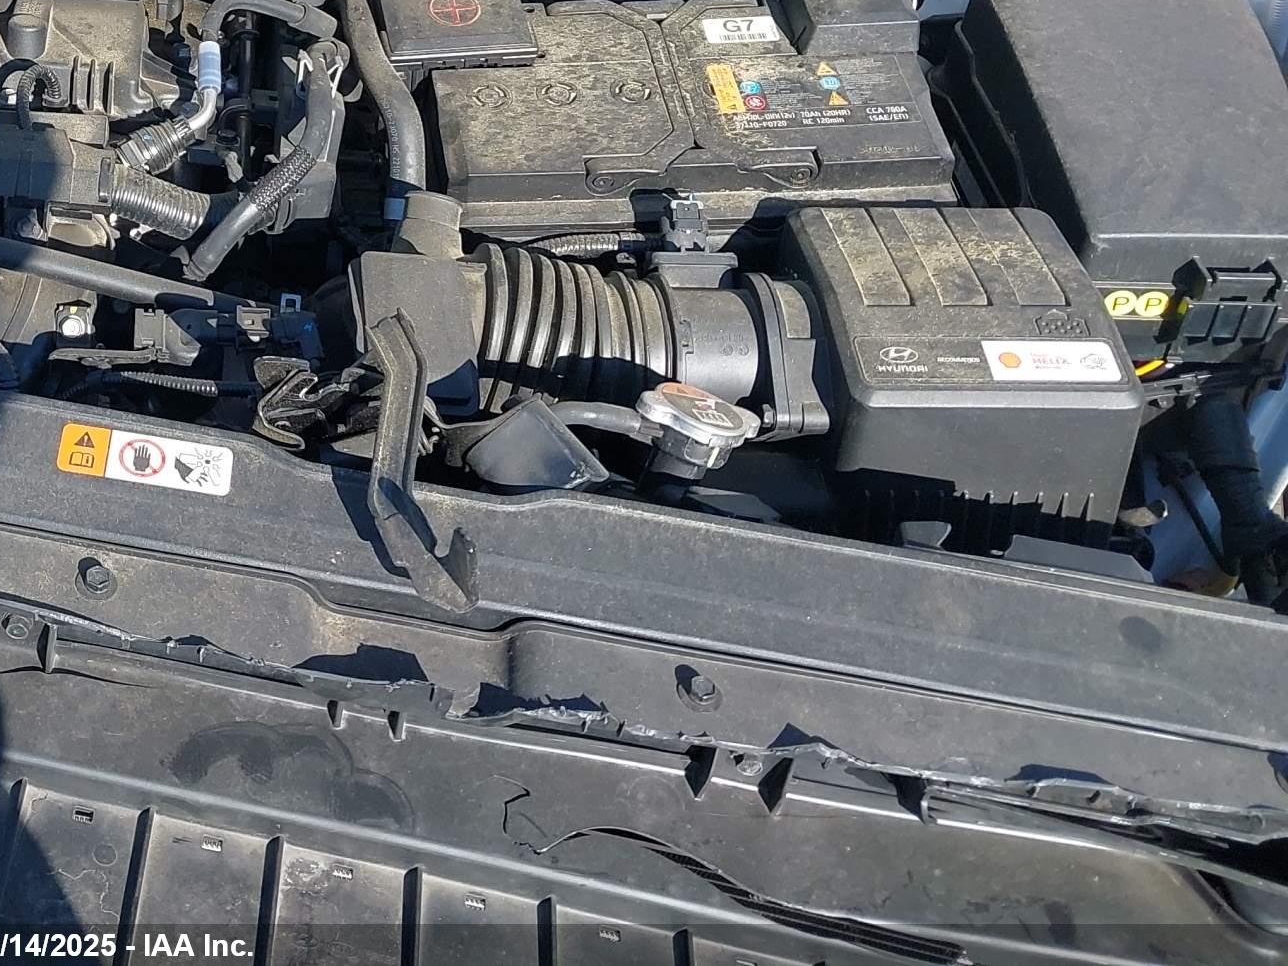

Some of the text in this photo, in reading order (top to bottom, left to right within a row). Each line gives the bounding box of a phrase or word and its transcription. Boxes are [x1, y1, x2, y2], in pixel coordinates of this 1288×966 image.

[723, 19, 755, 33] G7
[866, 106, 884, 115] CCA
[1112, 296, 1129, 311] P
[1144, 297, 1162, 312] P
[877, 364, 928, 374] HYUNDAI
